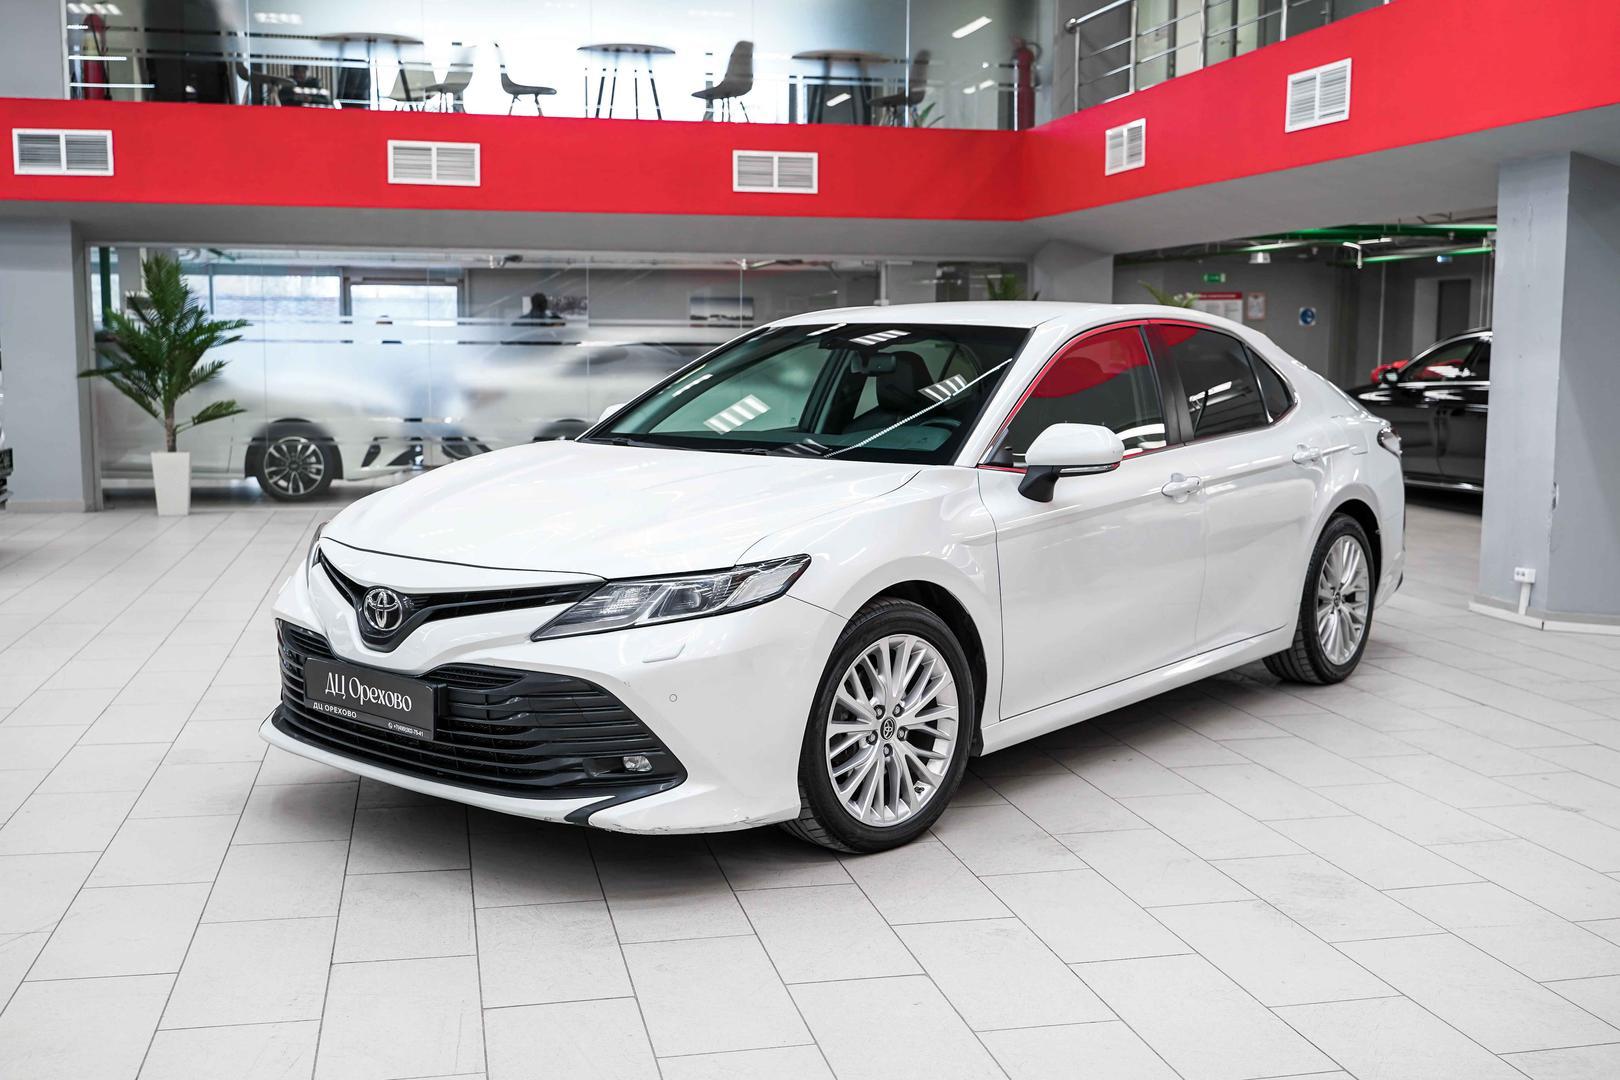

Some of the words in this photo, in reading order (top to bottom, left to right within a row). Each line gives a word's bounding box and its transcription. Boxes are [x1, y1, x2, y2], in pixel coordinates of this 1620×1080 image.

[325, 672, 346, 699] ДЦ
[349, 677, 412, 712] Орехово
[313, 702, 323, 710] ДЦ
[324, 704, 357, 718] ОРЕХОВО
